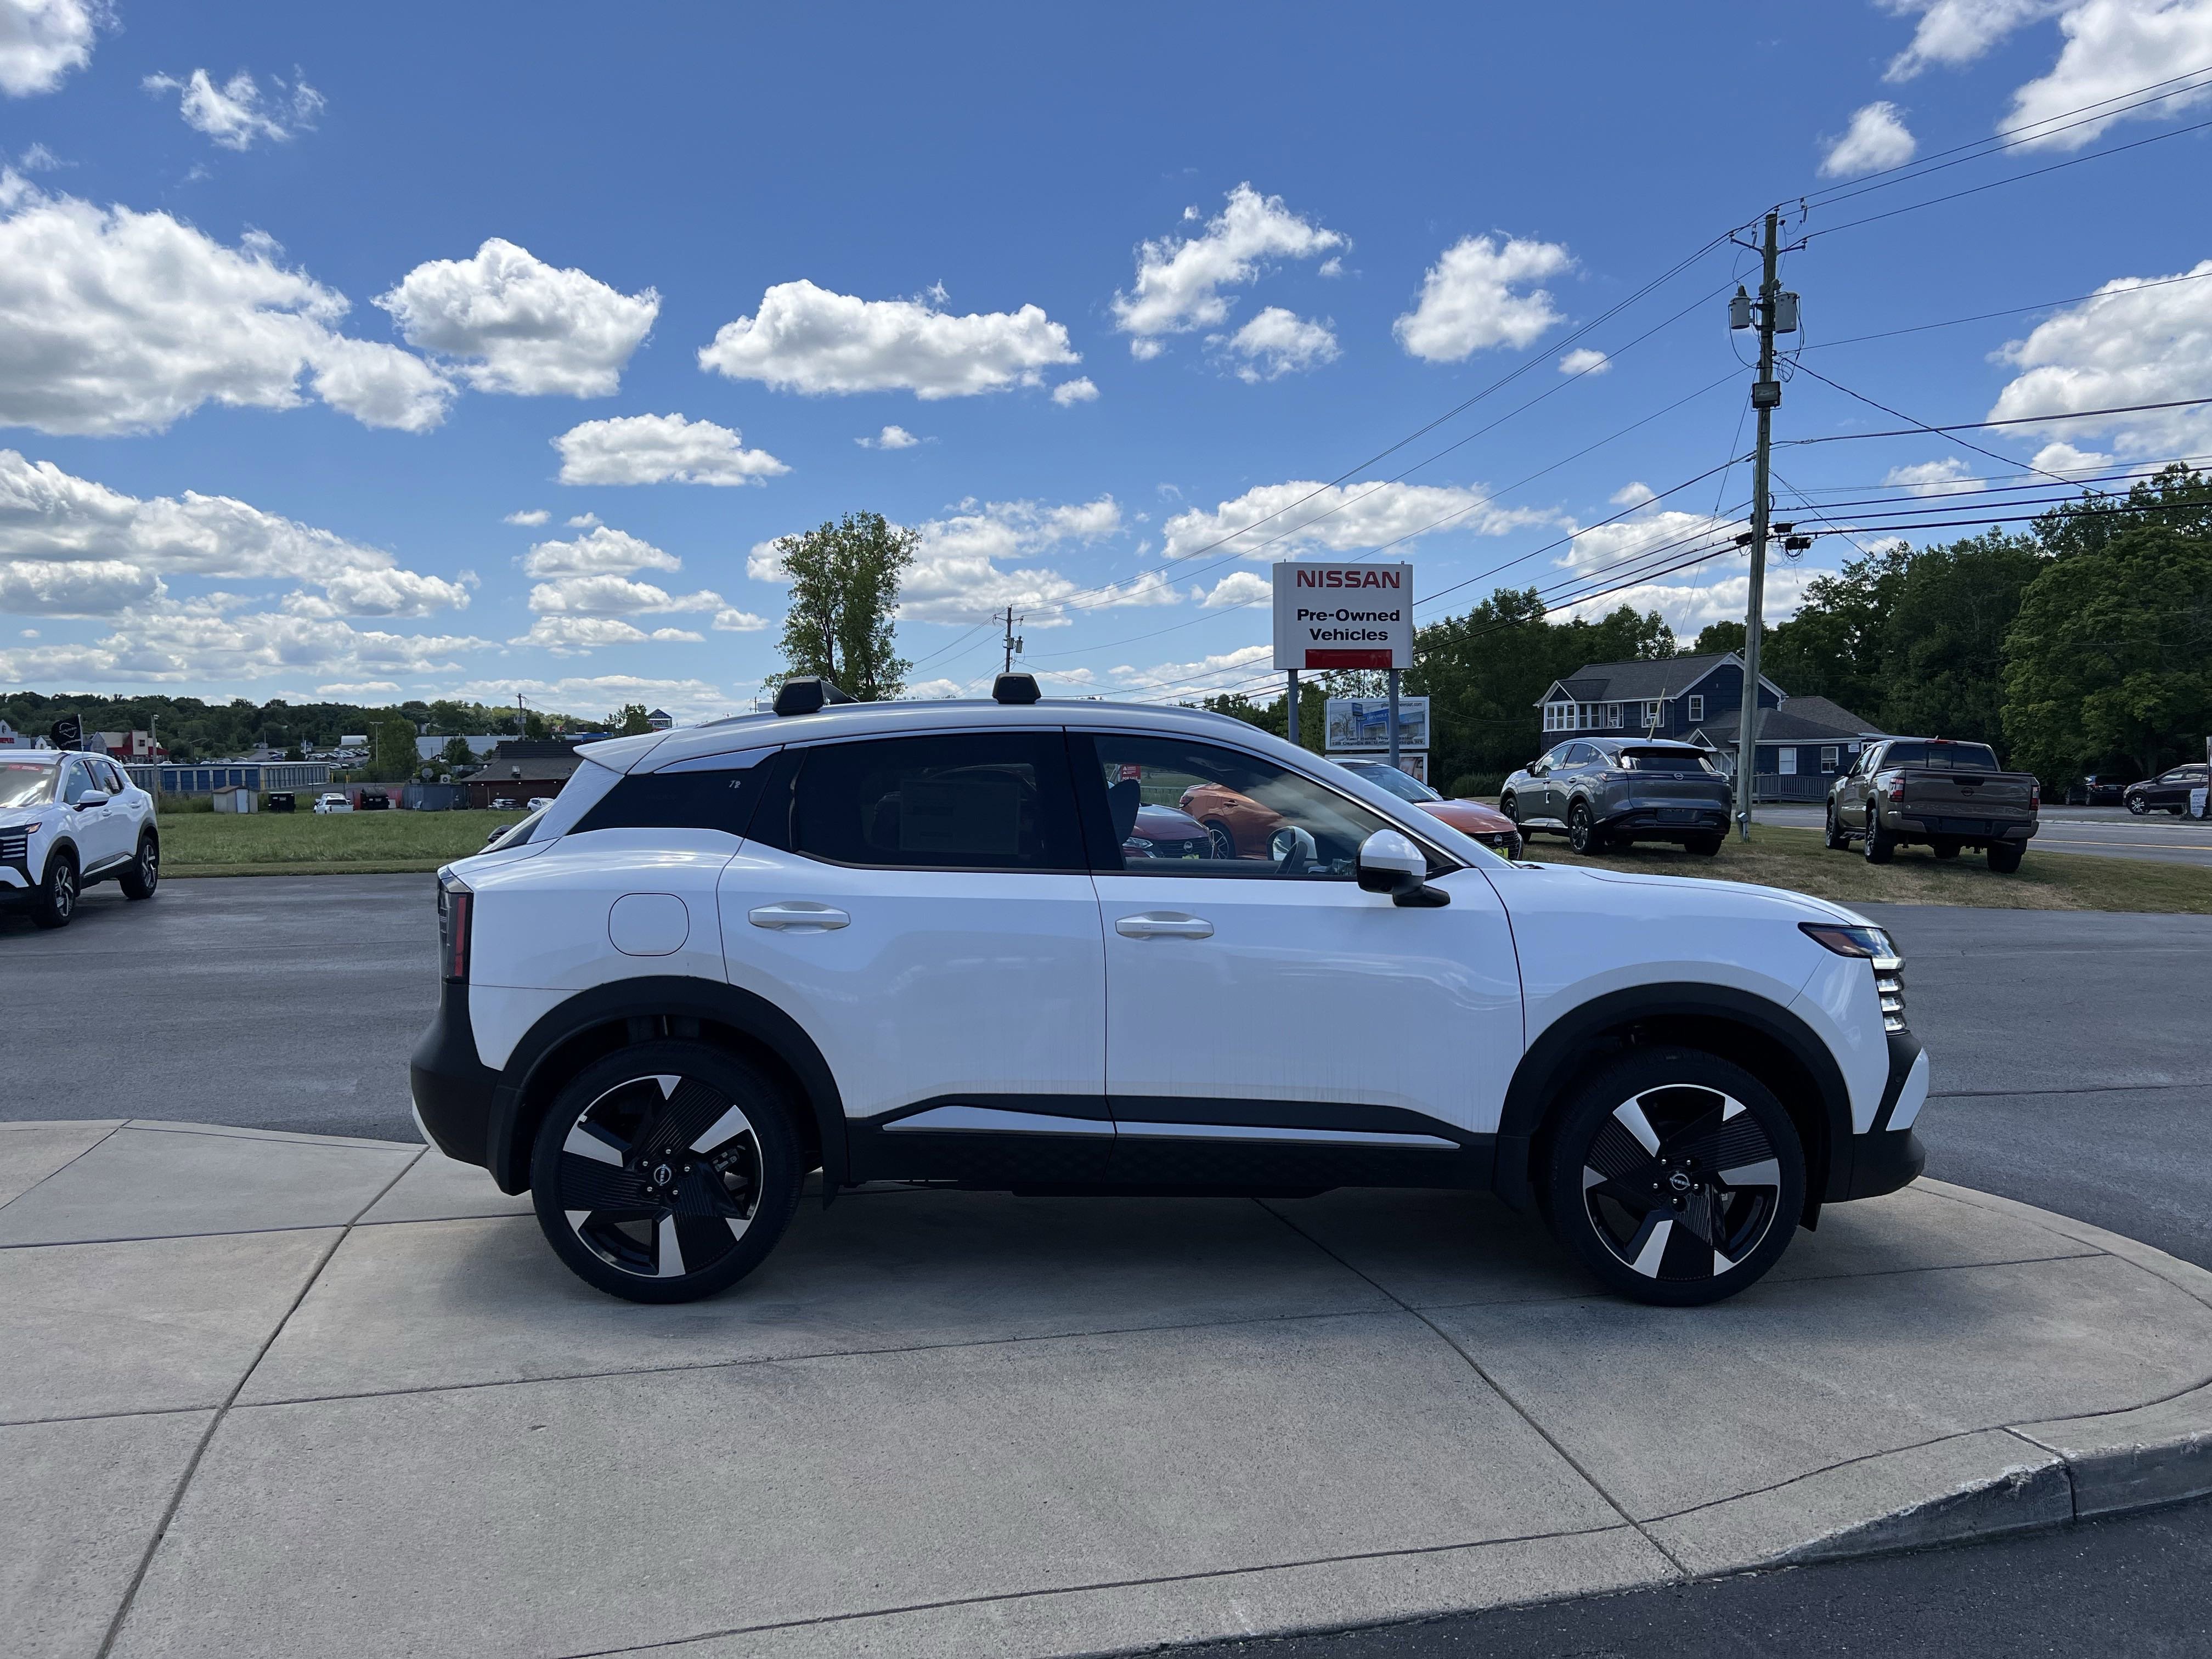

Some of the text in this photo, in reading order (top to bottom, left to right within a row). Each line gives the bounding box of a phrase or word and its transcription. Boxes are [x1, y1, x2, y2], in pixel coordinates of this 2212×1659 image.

[1297, 570, 1400, 588] NISSAN
[1297, 608, 1400, 622] Pre-Owned
[1309, 628, 1389, 641] Vehicles
